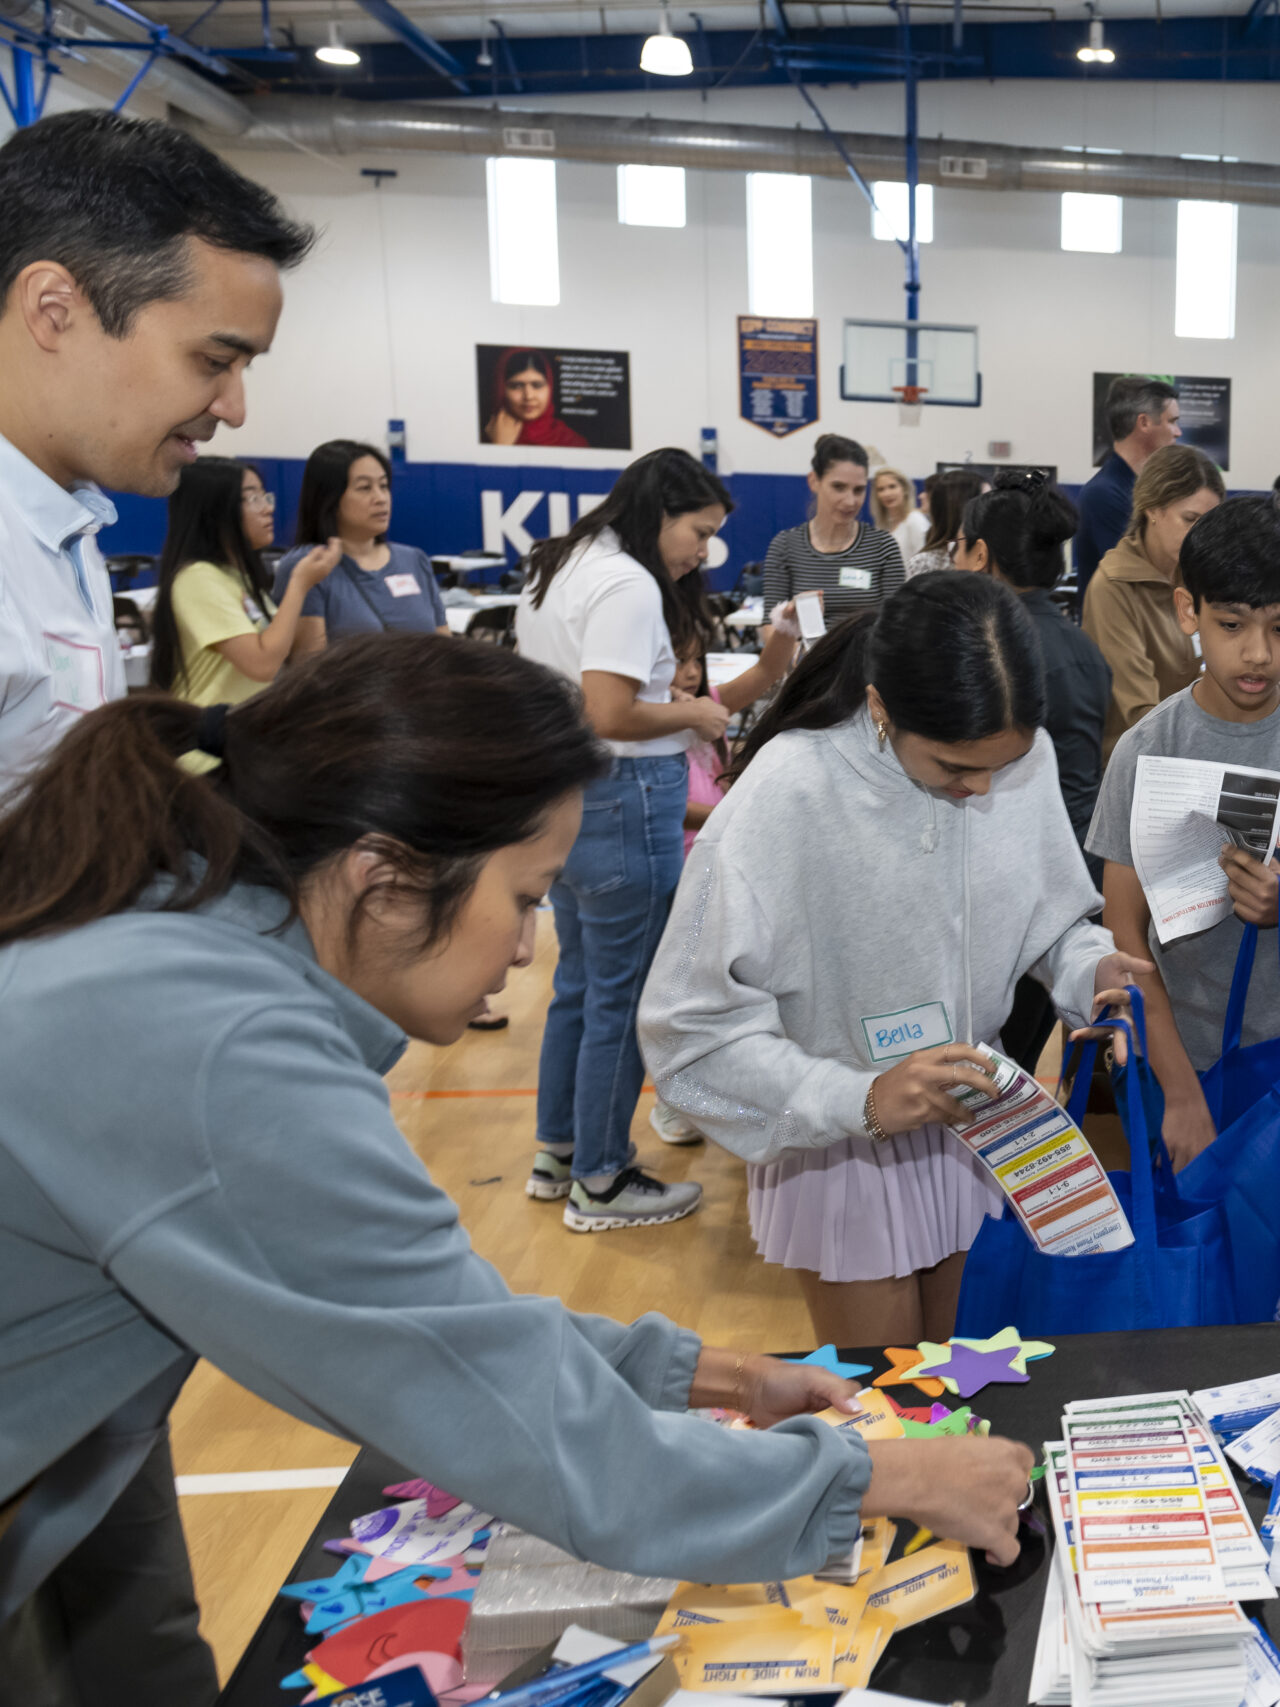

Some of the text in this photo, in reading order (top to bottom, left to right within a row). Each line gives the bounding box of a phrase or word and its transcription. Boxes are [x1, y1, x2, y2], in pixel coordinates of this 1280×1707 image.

[875, 1023, 924, 1048] Bella
[1014, 1131, 1035, 1146] 2-1-1
[1013, 1143, 1071, 1177] 855-492-8244
[1047, 1179, 1069, 1195] 9-1-1
[1056, 1222, 1121, 1255] Emergency Phone Numbe
[866, 1412, 886, 1427] RUN
[937, 1565, 959, 1581] RUN
[903, 1580, 926, 1596] HIDE
[703, 1667, 820, 1682] RUN HIDE FIGHT
